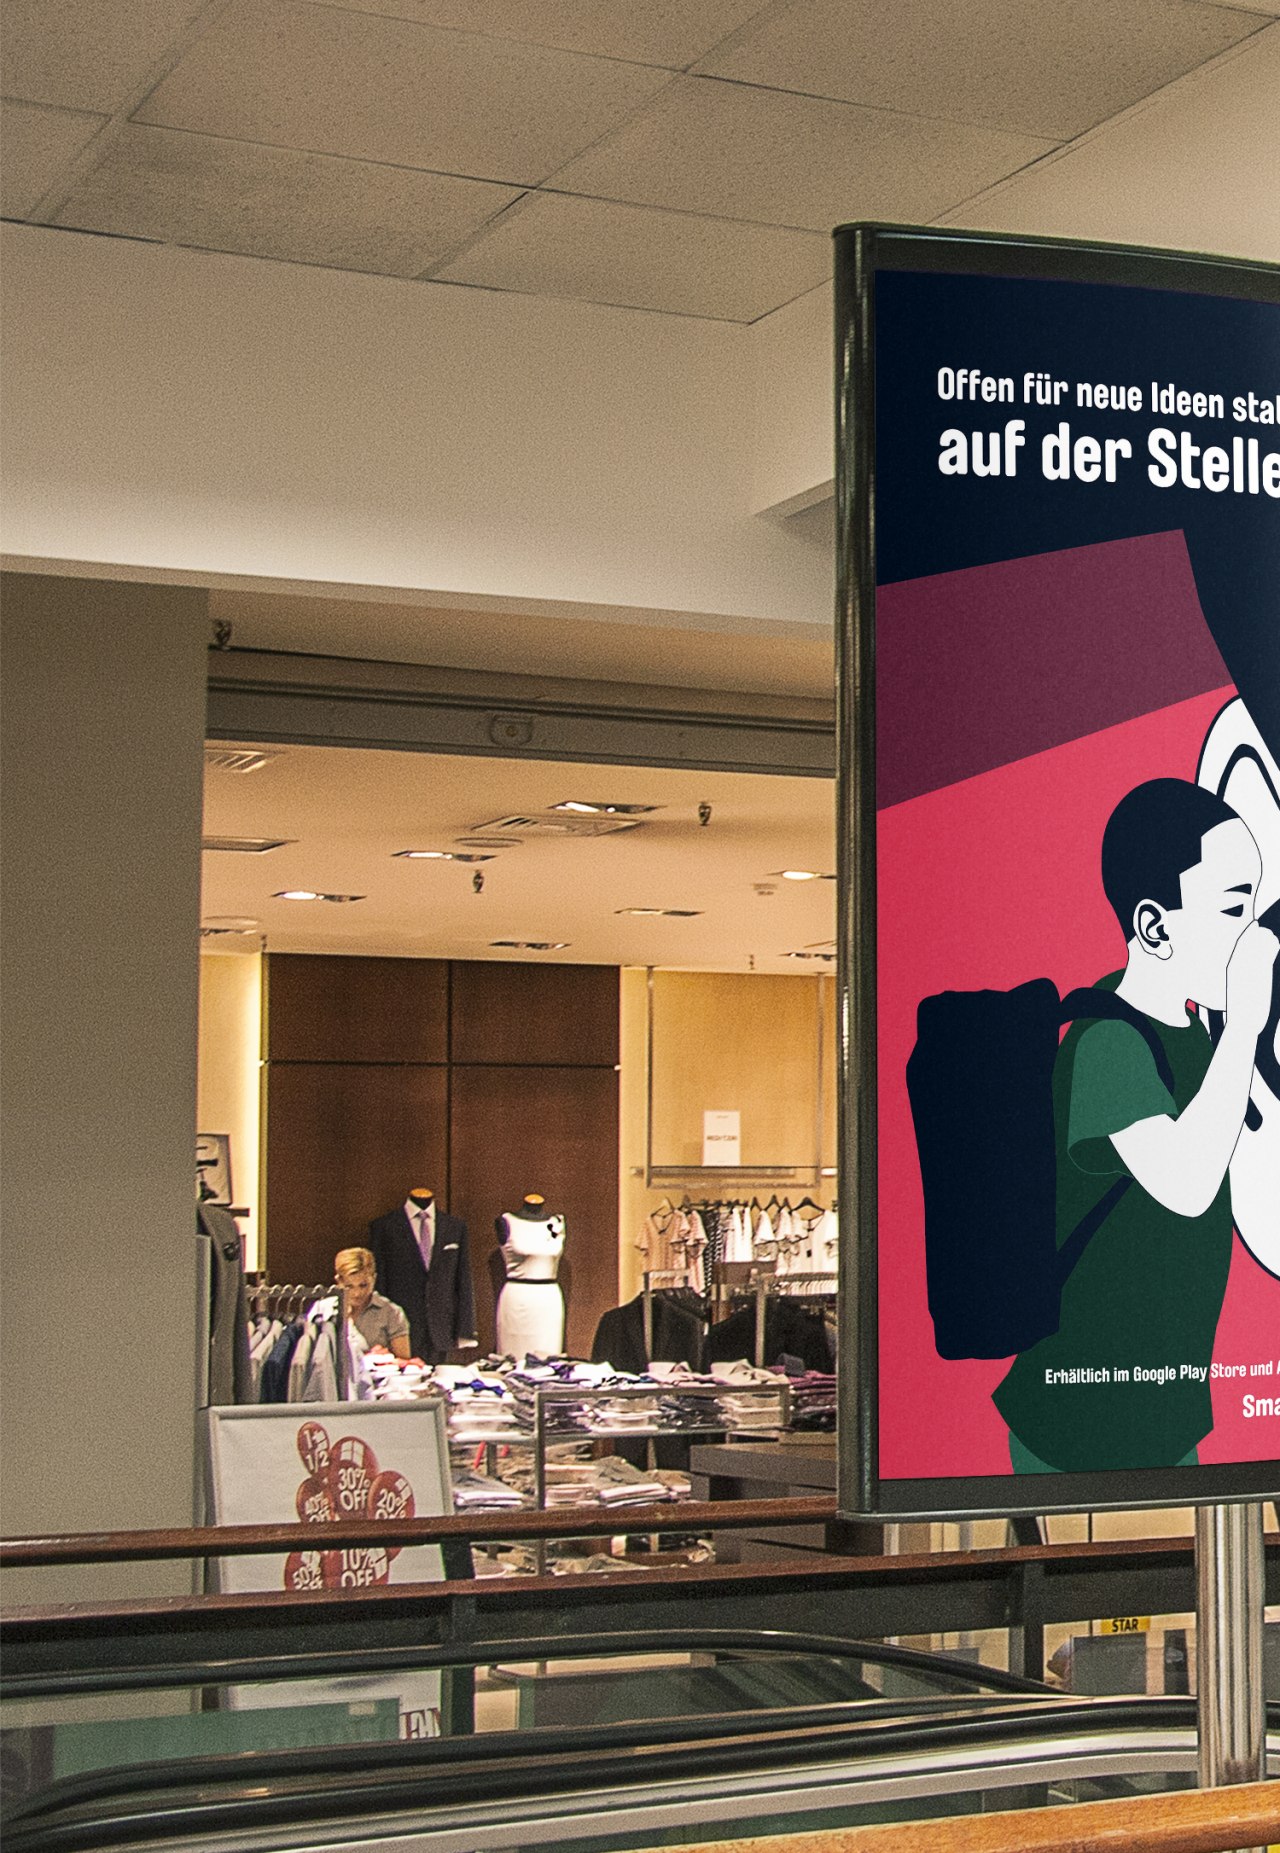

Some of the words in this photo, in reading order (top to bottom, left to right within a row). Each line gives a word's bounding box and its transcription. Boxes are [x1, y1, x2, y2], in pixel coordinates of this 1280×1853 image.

[937, 367, 1015, 403] Offen
[1023, 372, 1070, 405] für
[1077, 381, 1143, 412] neue
[1151, 381, 1225, 419] Ideen
[938, 419, 1026, 477] auf
[1042, 422, 1133, 483] der
[1045, 1367, 1110, 1384] Erhältlich
[1113, 1367, 1130, 1382] im
[1133, 1365, 1177, 1385] Google
[1180, 1364, 1208, 1383] Play
[1210, 1362, 1247, 1379] Store
[1250, 1360, 1273, 1377] und
[338, 1467, 371, 1491] 30%
[340, 1488, 368, 1511] OFF
[1111, 1618, 1139, 1633] STAR
